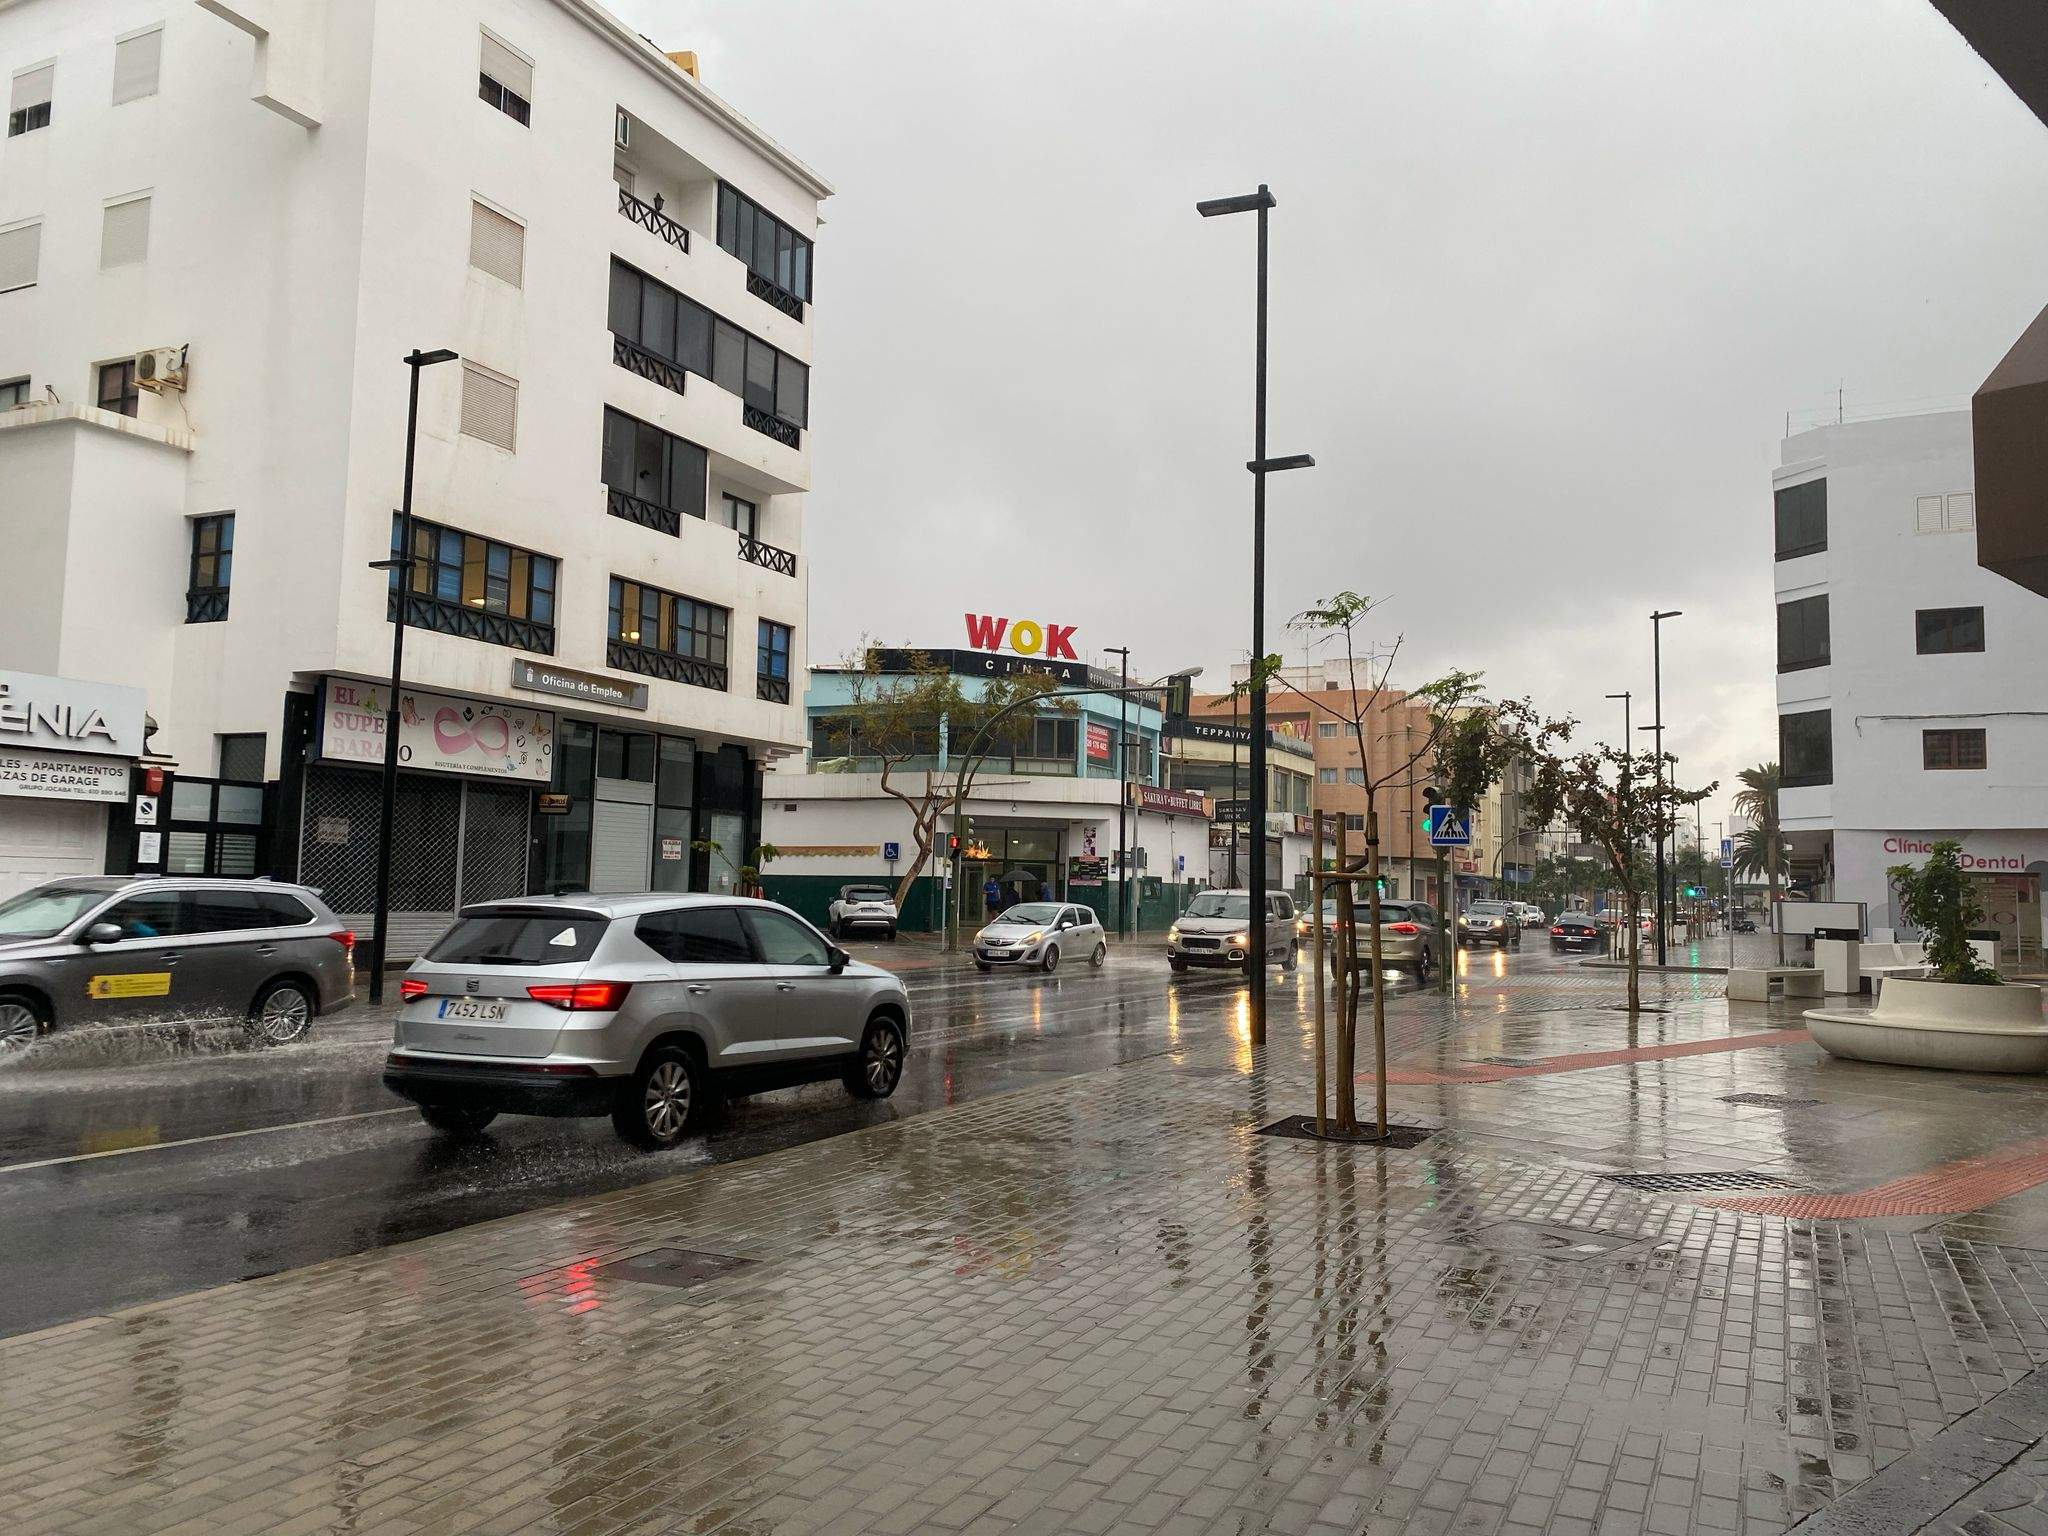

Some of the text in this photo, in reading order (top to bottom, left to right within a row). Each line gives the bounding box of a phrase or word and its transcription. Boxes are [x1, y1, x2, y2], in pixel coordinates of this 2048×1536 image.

[965, 613, 1079, 660] WOK
[985, 660, 1071, 678] CINTA
[542, 674, 623, 699] Oficina de Empleo
[333, 686, 360, 706] EL
[333, 711, 387, 734] SUPE
[331, 736, 413, 762] BARAO
[32, 761, 123, 777] APARTAMENTOS
[467, 764, 508, 774] COMPLEMENTOS
[0, 771, 99, 787] ZAS DE GARAGE
[1170, 796, 1188, 809] BUFFET
[1189, 799, 1202, 811] LIBRE
[1883, 838, 1932, 853] Clínic
[1960, 854, 2025, 869] Dental
[447, 1002, 506, 1020] 7452 LSN
